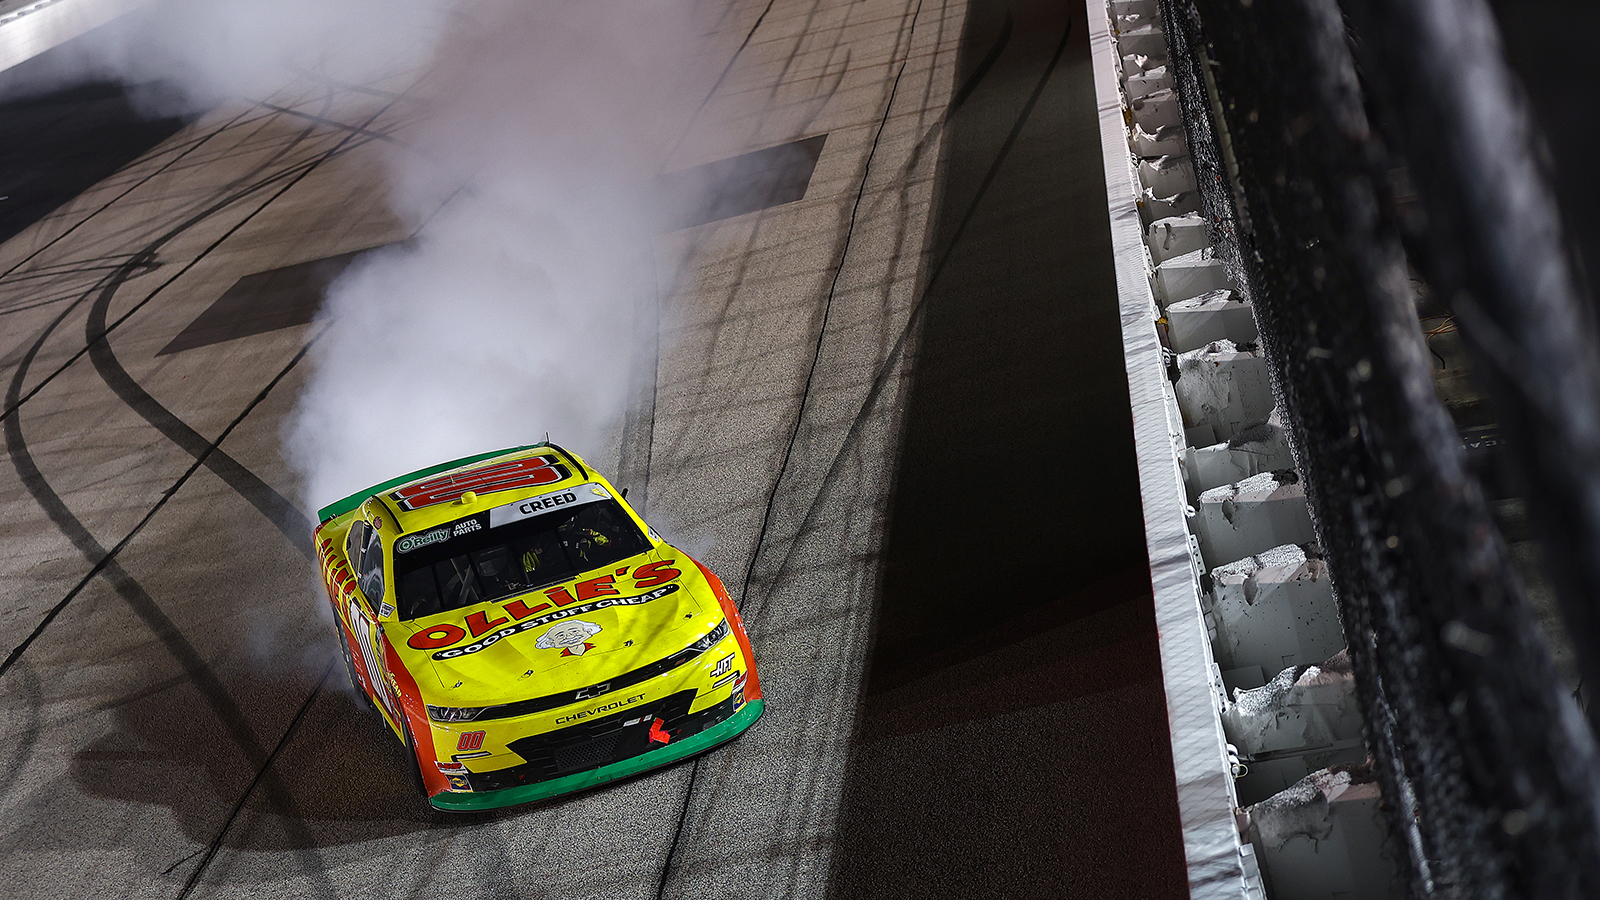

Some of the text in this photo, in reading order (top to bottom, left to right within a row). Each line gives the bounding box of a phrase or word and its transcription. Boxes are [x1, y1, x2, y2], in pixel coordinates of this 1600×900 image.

[519, 492, 577, 515] CREED
[453, 523, 482, 537] PARTS
[455, 519, 477, 531] AUTO
[398, 529, 450, 552] O'Reilly
[521, 604, 592, 630] STUFF
[555, 693, 646, 725] CHEVROLET
[456, 730, 486, 751] 00
